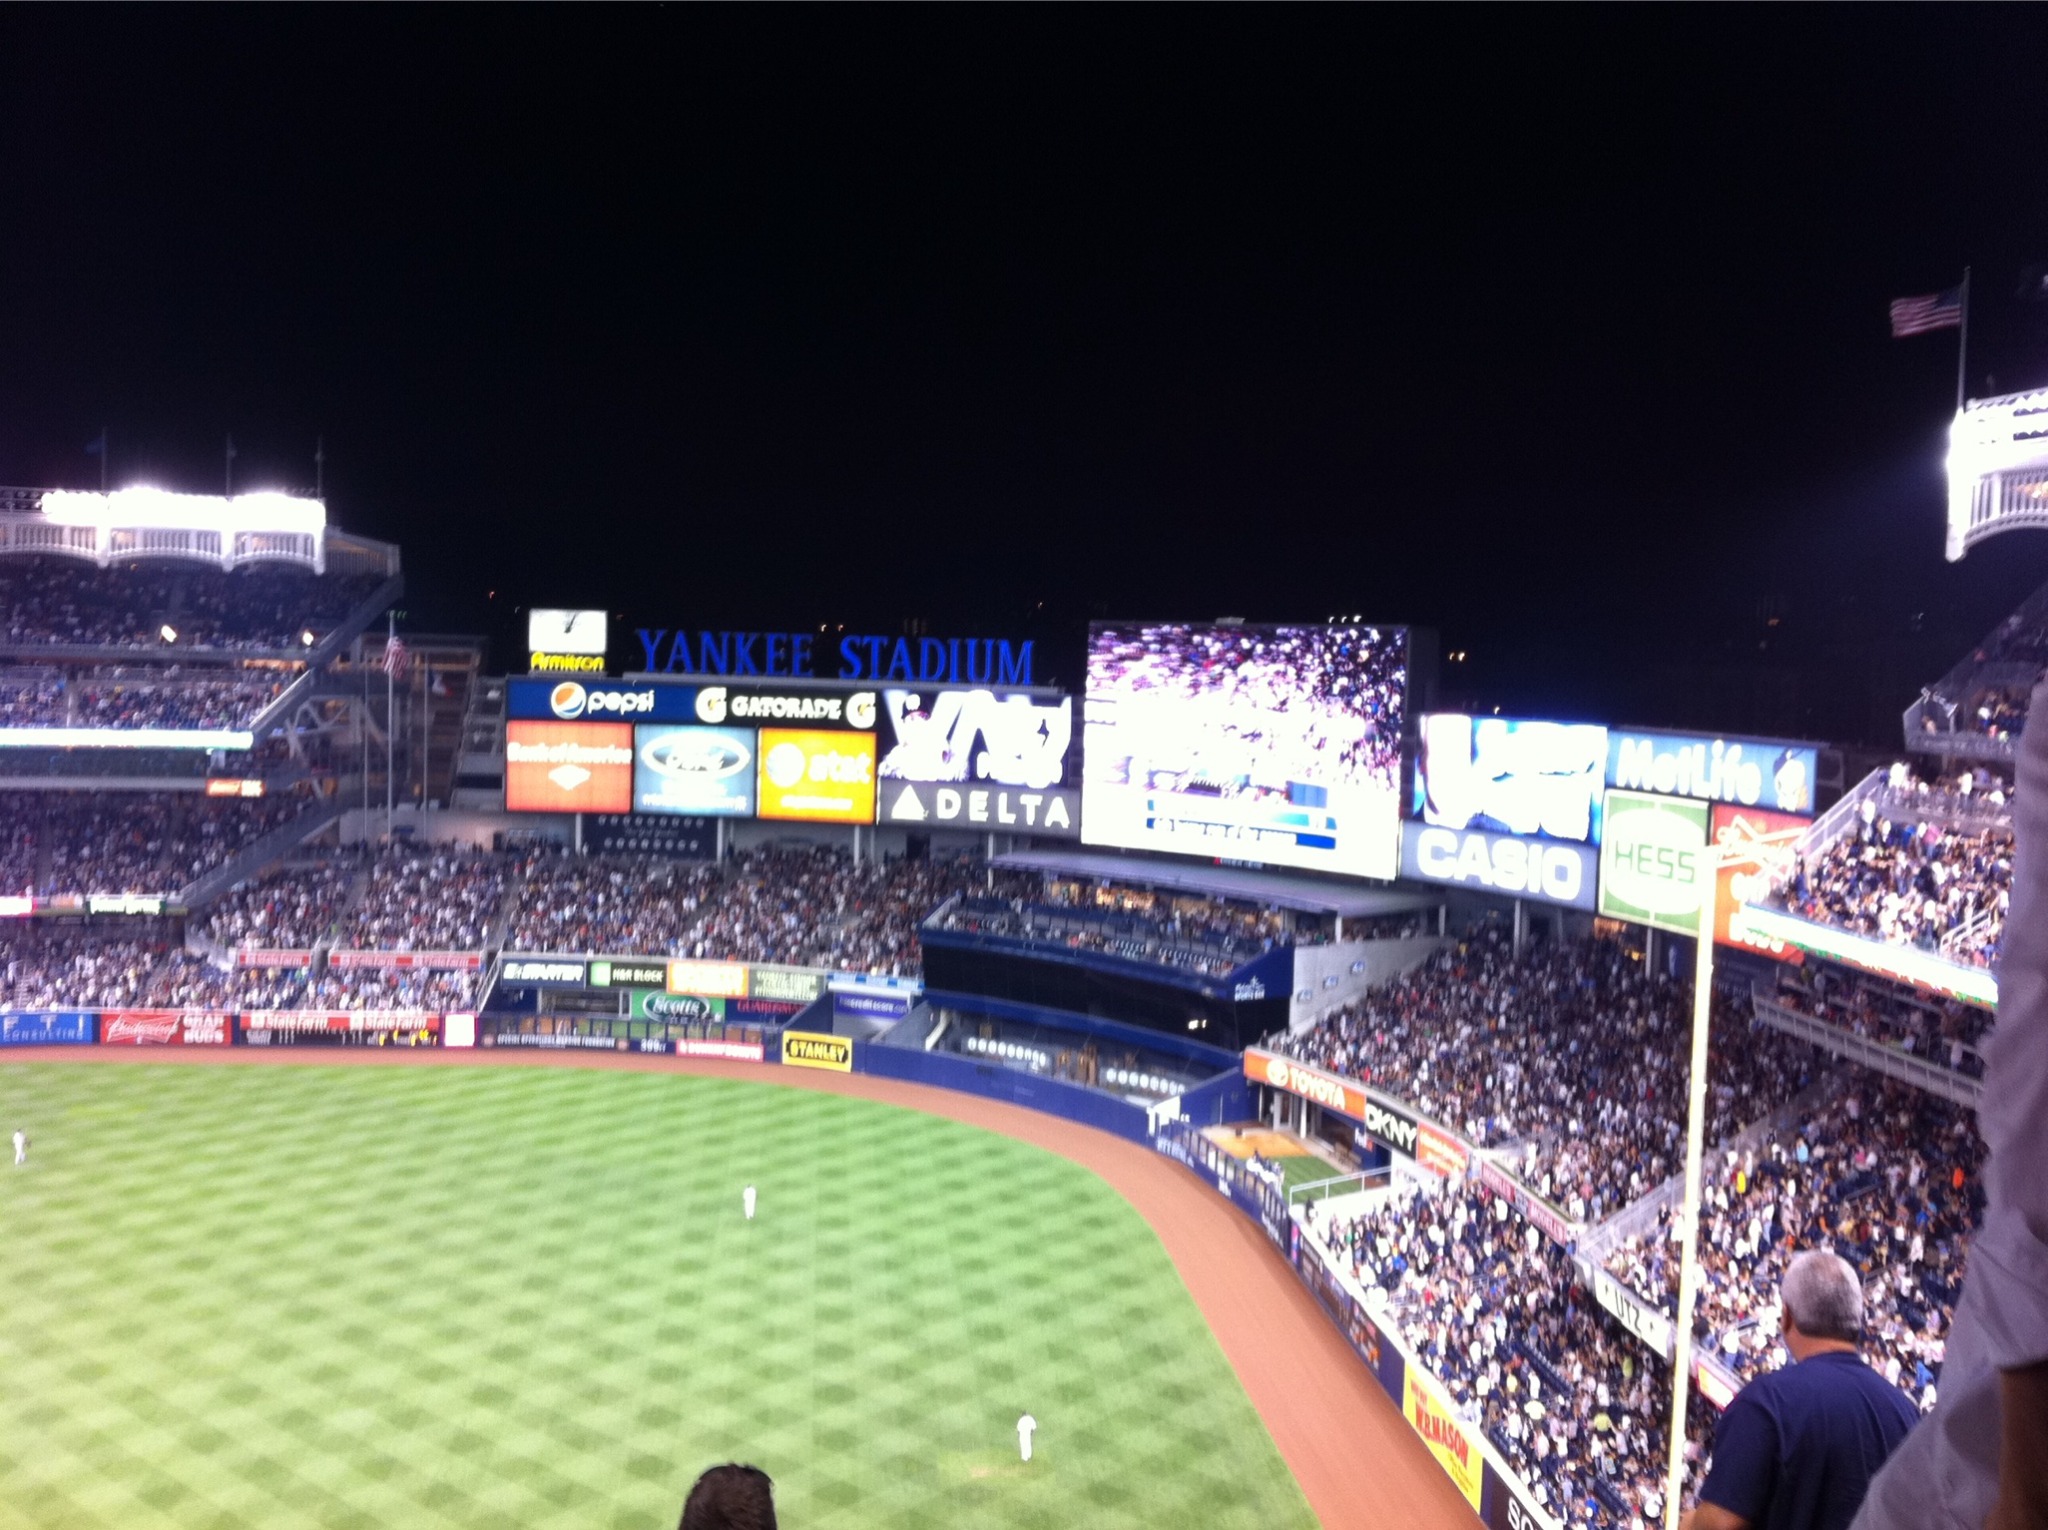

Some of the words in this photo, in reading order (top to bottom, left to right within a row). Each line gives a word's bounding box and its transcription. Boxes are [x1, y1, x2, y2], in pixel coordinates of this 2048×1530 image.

[530, 652, 605, 671] Armitron
[635, 629, 814, 676] YANKEE
[838, 634, 1036, 686] STADIUM
[587, 690, 655, 715] pepsi
[731, 696, 841, 719] GATORADE
[1616, 739, 1762, 804] MetLife
[937, 788, 1070, 829] DELTA
[1417, 829, 1582, 900] CASIO
[1615, 841, 1695, 882] HESS
[266, 1013, 294, 1028] State
[297, 1014, 327, 1029] Farm
[366, 1014, 395, 1030] State
[400, 1014, 427, 1030] Farm
[789, 1040, 846, 1063] STANLEY
[1289, 1068, 1346, 1110] TOYOTA
[1365, 1105, 1417, 1152] DKNY
